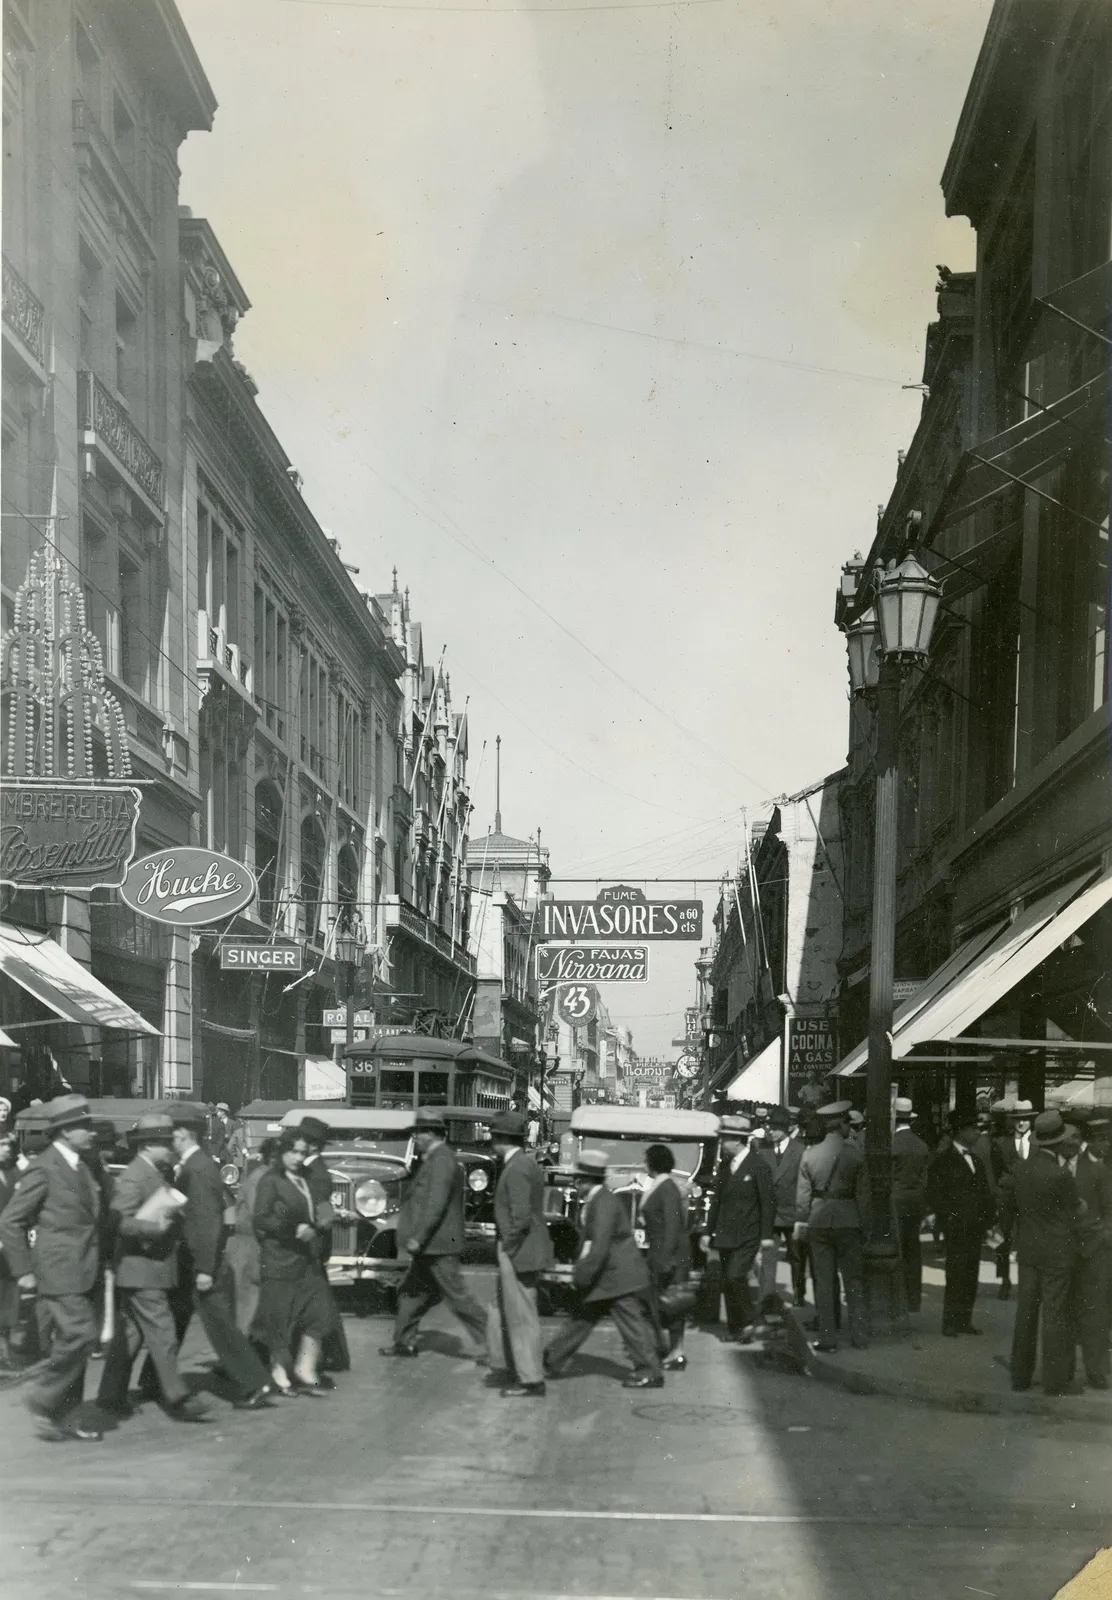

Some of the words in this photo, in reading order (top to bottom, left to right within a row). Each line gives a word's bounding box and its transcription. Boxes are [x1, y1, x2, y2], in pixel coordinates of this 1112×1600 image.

[137, 858, 243, 906] Hucke
[604, 891, 638, 901] FUME
[544, 904, 678, 935] INVASORES
[679, 911, 686, 920] a
[686, 908, 698, 920] 60
[681, 921, 696, 933] cts
[227, 949, 296, 965] SINGER
[591, 949, 645, 960] FAJAS
[540, 949, 645, 979] Nirvana
[563, 986, 591, 1018] 43
[327, 1013, 371, 1023] ROAL
[796, 1020, 829, 1032] USE
[791, 1034, 834, 1050] COCINA
[792, 1052, 801, 1063] A
[805, 1051, 833, 1063] GAS
[354, 1060, 374, 1073] 36
